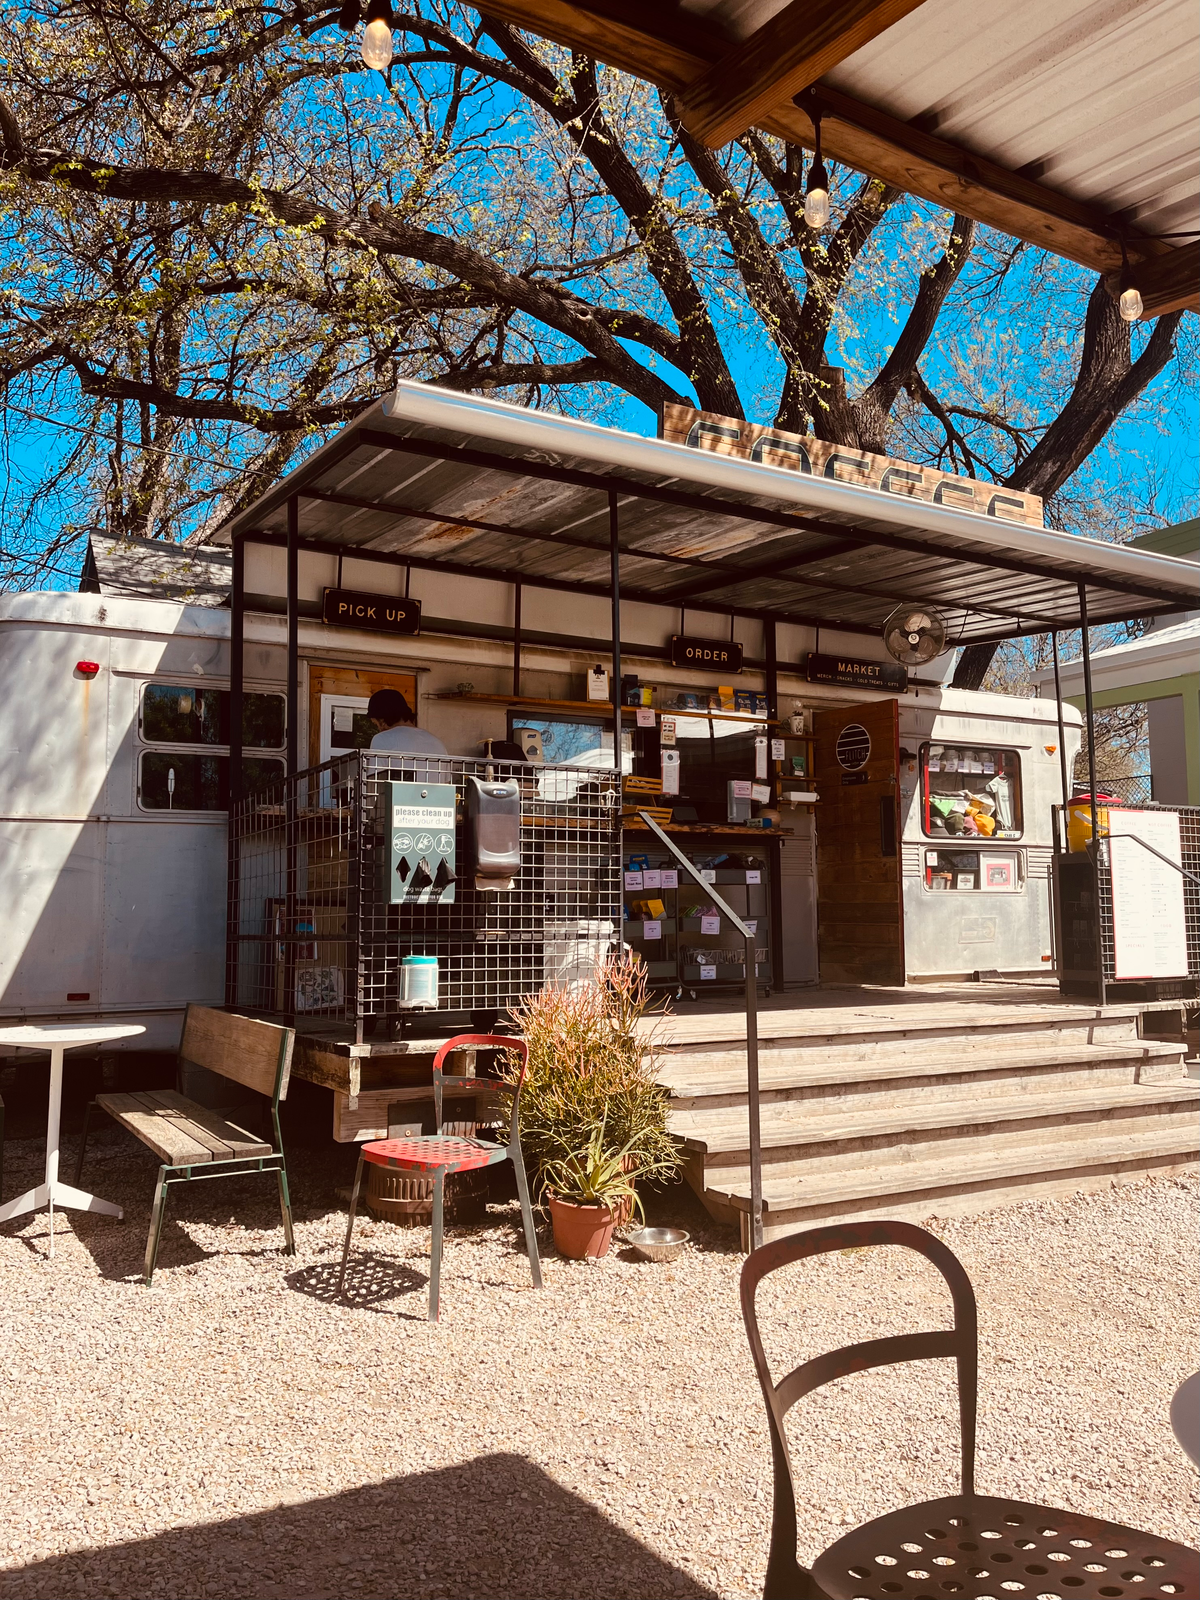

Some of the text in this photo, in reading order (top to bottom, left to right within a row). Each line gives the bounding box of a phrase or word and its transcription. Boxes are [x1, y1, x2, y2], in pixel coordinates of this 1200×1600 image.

[338, 602, 406, 622] PICK UP
[686, 647, 728, 662] ORDER
[837, 662, 881, 676] MARKET
[845, 749, 866, 760] FLITCH
[395, 808, 453, 818] please clean up
[416, 818, 434, 826] your
[435, 818, 450, 826] dog
